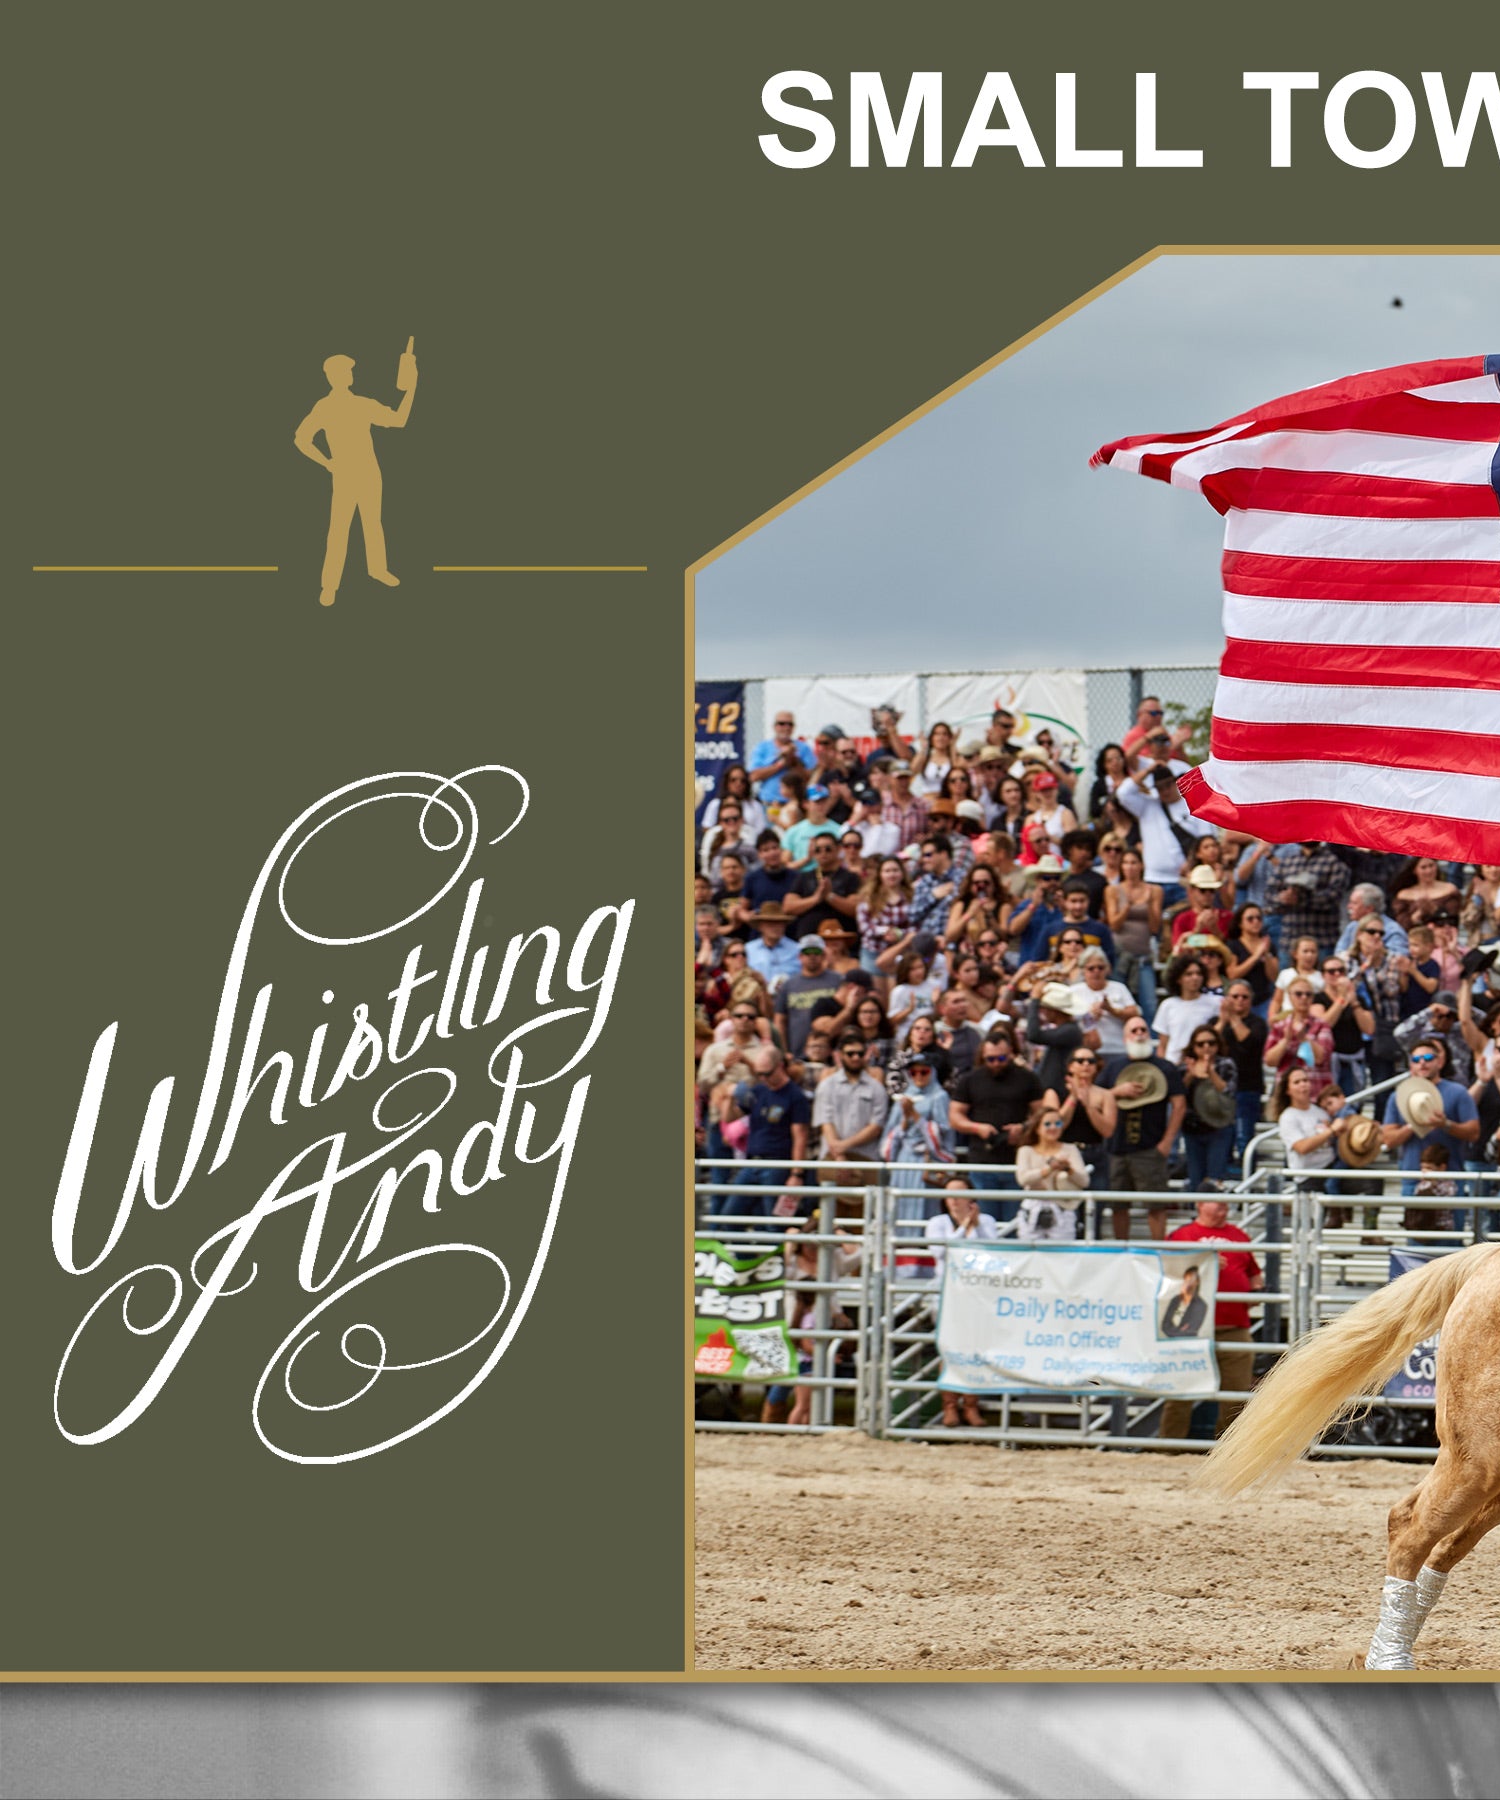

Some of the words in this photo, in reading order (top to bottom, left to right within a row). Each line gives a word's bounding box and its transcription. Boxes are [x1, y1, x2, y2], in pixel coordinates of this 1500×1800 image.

[996, 1296, 1051, 1324] Daily
[1025, 1330, 1065, 1348] Loan
[1069, 1330, 1122, 1350] Officer
